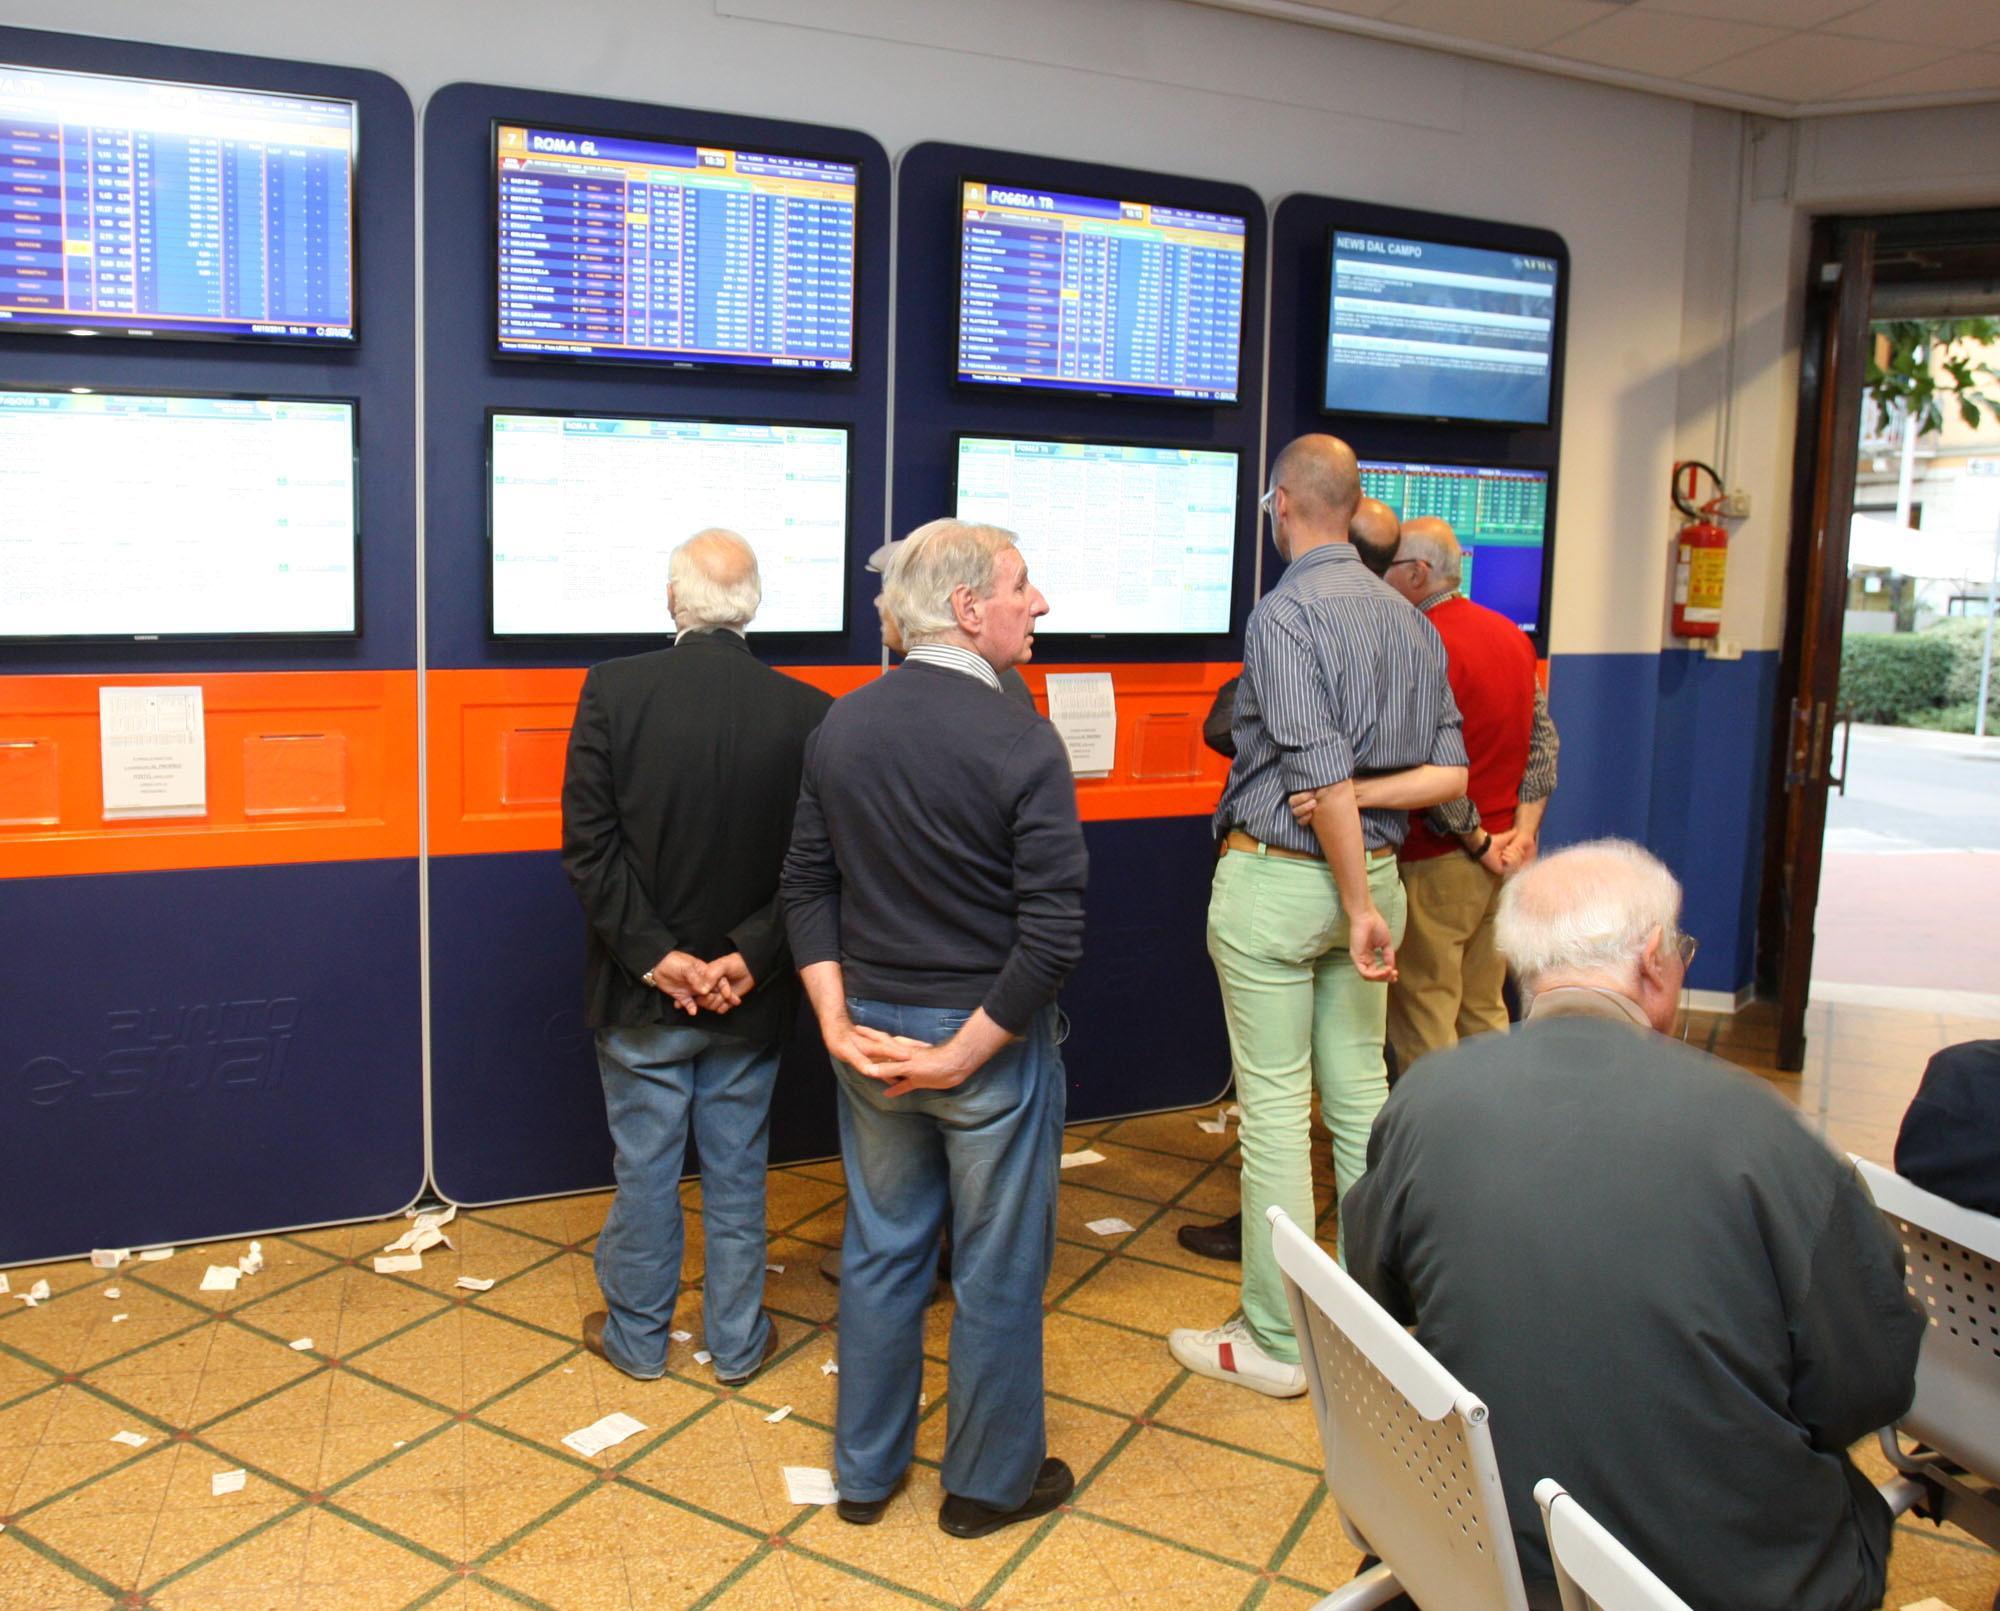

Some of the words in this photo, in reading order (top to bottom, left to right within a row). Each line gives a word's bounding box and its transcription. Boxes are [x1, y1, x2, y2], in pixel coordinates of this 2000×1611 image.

[533, 135, 577, 155] ROMA
[990, 190, 1035, 209] FOGGIA
[1038, 196, 1054, 211] TR
[1336, 236, 1366, 251] NEWS
[1366, 240, 1386, 254] DAL
[1387, 244, 1422, 259] CAMPO
